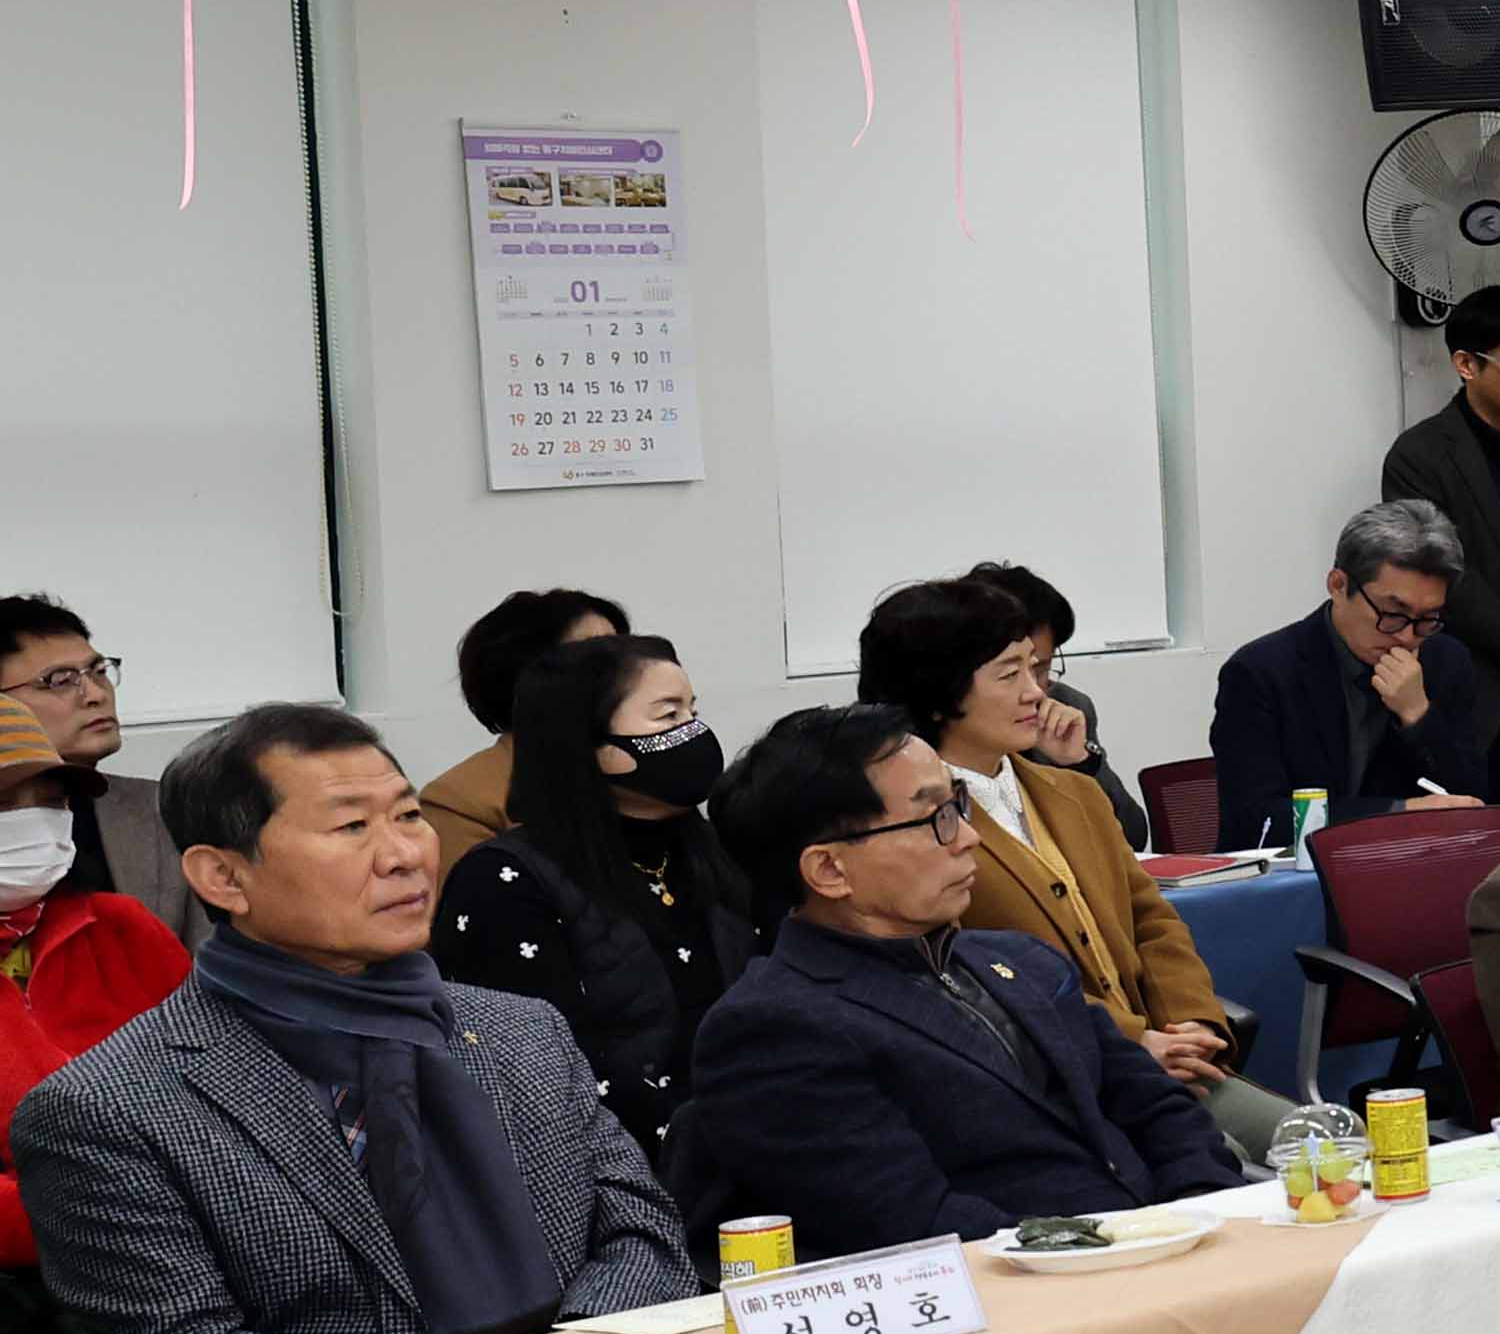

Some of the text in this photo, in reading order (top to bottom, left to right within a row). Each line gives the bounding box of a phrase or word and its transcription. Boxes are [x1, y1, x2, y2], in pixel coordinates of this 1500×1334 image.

[571, 280, 599, 303] 01
[586, 323, 668, 336] 1 2 3 4
[510, 351, 671, 367] 5 6 7 8 9 10 11
[508, 380, 674, 397] 12 13 14 15 16 17 18
[512, 408, 677, 427] 19 20 21 22 23 24 25
[512, 438, 654, 457] 26 27 28 29 30 31
[771, 1281, 846, 1308] 주민자치회
[854, 1273, 883, 1292] 회장
